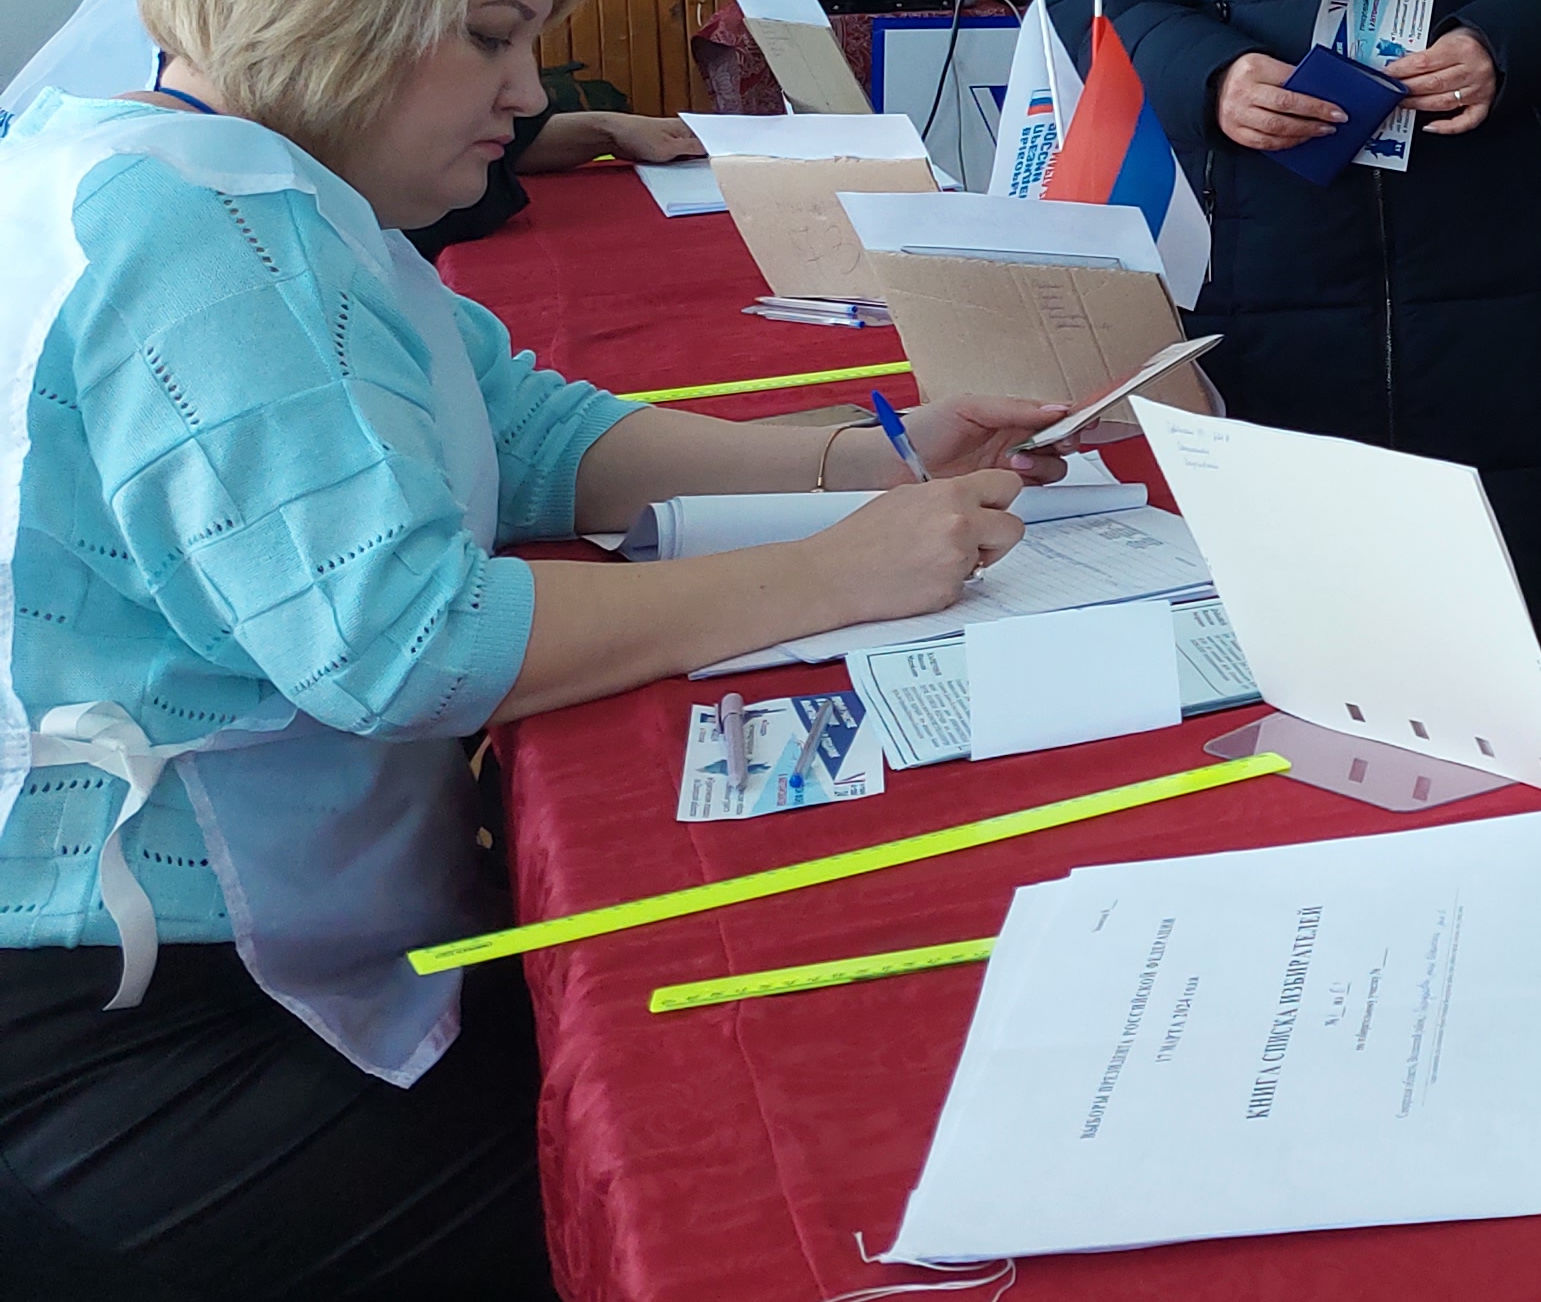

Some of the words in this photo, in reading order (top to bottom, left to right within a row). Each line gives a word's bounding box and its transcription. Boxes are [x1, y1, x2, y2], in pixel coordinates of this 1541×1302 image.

[1279, 905, 1323, 1006] ИЗБИРАТЕЛЕЙ
[1080, 1095, 1110, 1139] ВЫБОРЫ
[1122, 971, 1157, 1036] РОССИЙСКОЙ
[1146, 918, 1176, 969] ФЕДЕРАЦИИ
[1159, 1021, 1186, 1051] МАРТА
[1173, 998, 1192, 1020] 2024
[1261, 1008, 1299, 1063] СПИСКА
[1246, 1064, 1283, 1119] КНИГА
